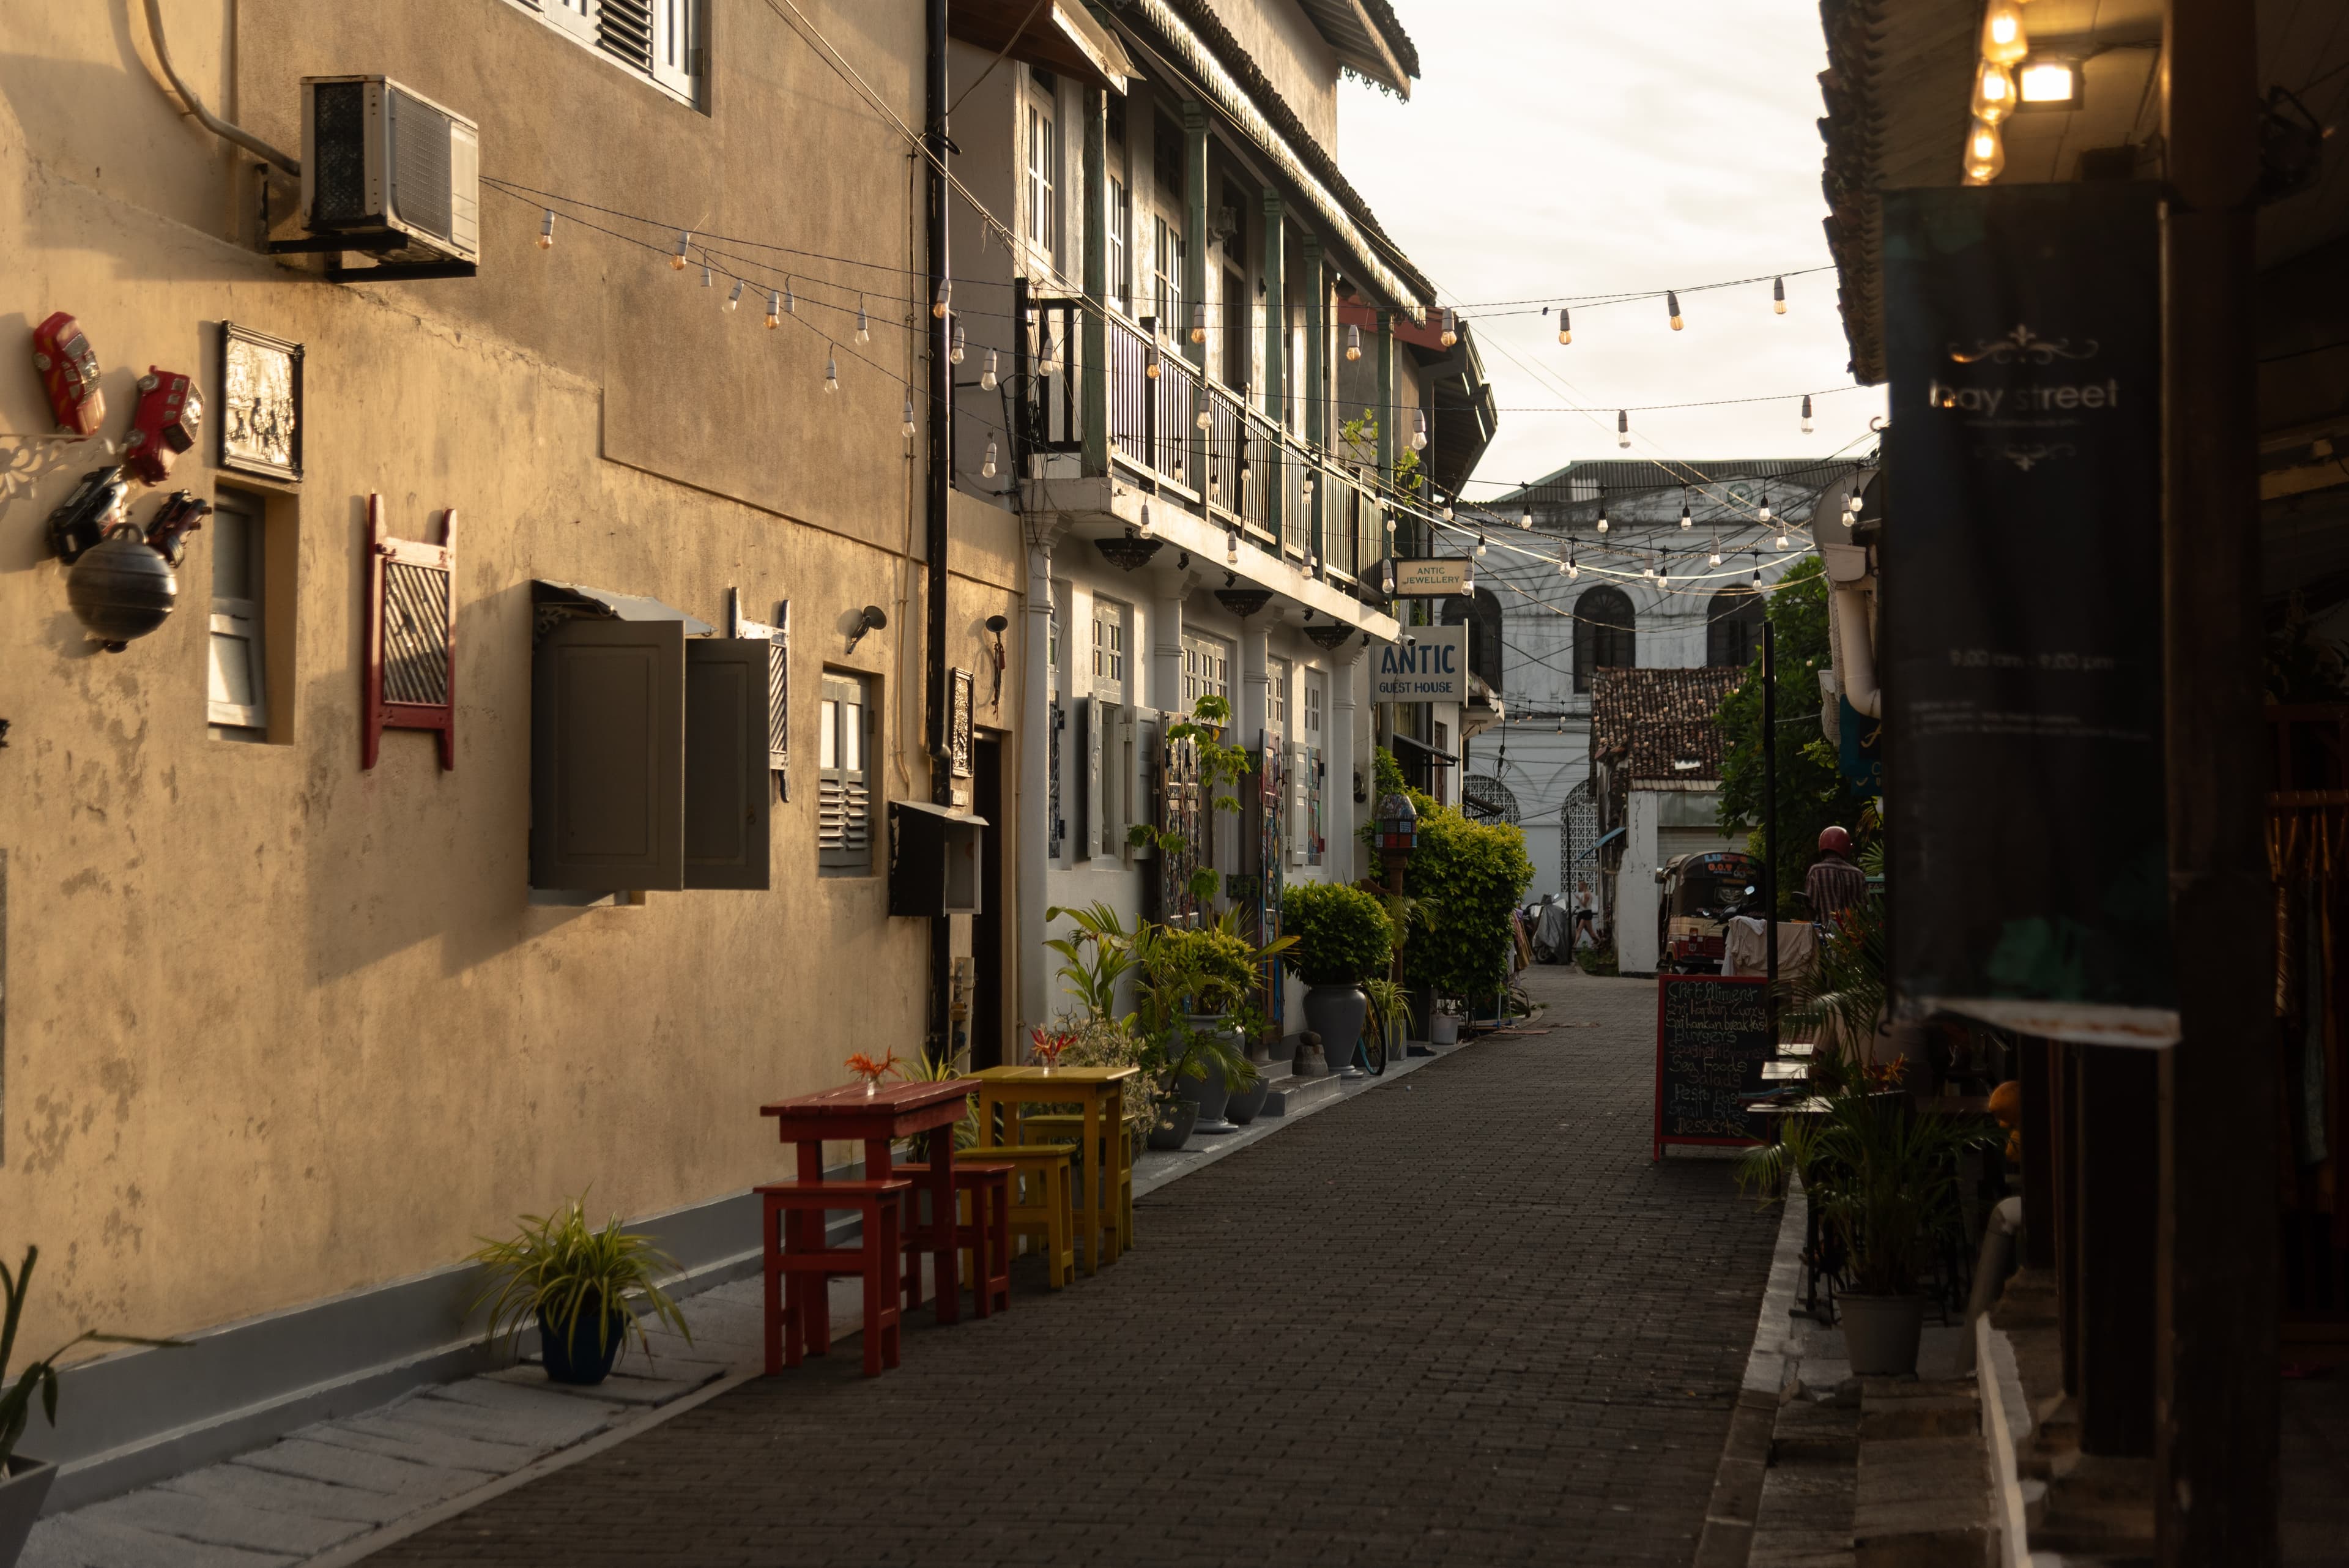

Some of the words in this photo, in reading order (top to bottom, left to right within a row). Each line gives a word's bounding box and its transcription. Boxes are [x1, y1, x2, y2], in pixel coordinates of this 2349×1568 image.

[2015, 378, 2121, 411] street
[1381, 644, 1455, 674] ANTIC
[1379, 681, 1412, 694] GUEST
[1414, 682, 1453, 694] HOUSE
[1675, 1027, 1737, 1044] Burgers
[1669, 1054, 1699, 1072] Sea
[1704, 1057, 1748, 1072] Foods
[1686, 1071, 1742, 1088] Salads
[1669, 1101, 1702, 1118] Small
